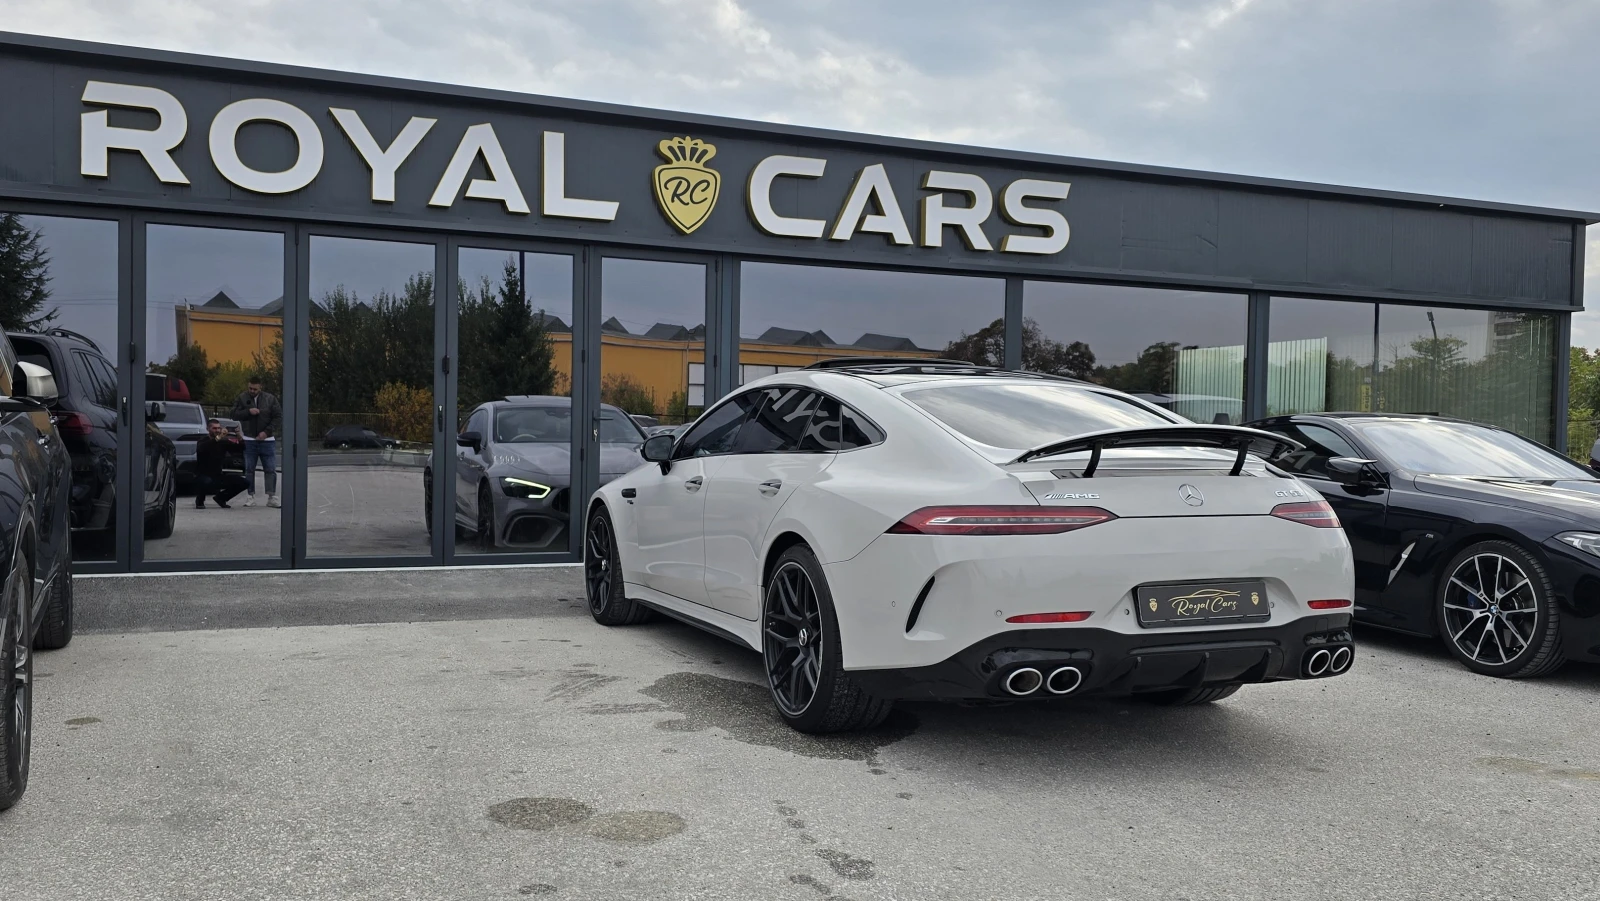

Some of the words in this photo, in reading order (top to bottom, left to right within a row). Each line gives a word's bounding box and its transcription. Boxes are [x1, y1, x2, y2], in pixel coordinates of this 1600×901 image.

[80, 80, 620, 221] ROYAL
[663, 176, 711, 206] RC
[746, 154, 1072, 254] CARS
[1171, 598, 1209, 616] Royal
[1211, 597, 1238, 613] Cars
